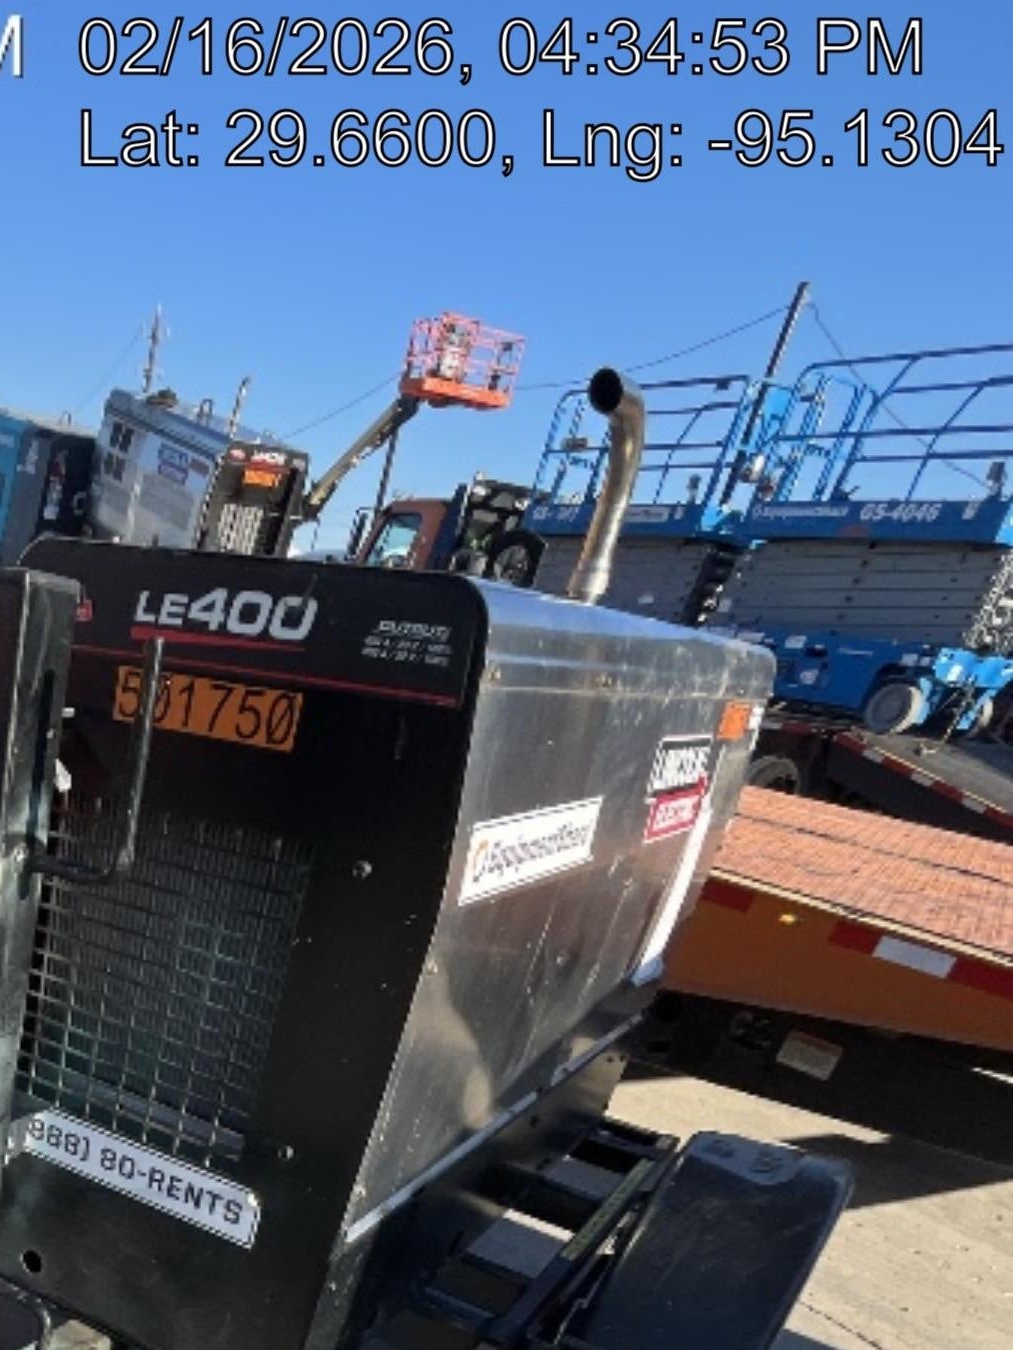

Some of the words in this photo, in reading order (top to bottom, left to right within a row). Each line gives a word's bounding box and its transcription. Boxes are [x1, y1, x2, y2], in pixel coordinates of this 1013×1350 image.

[134, 587, 318, 641] LE400
[118, 671, 296, 745] 501750
[100, 1148, 243, 1225] 80-RENTS
